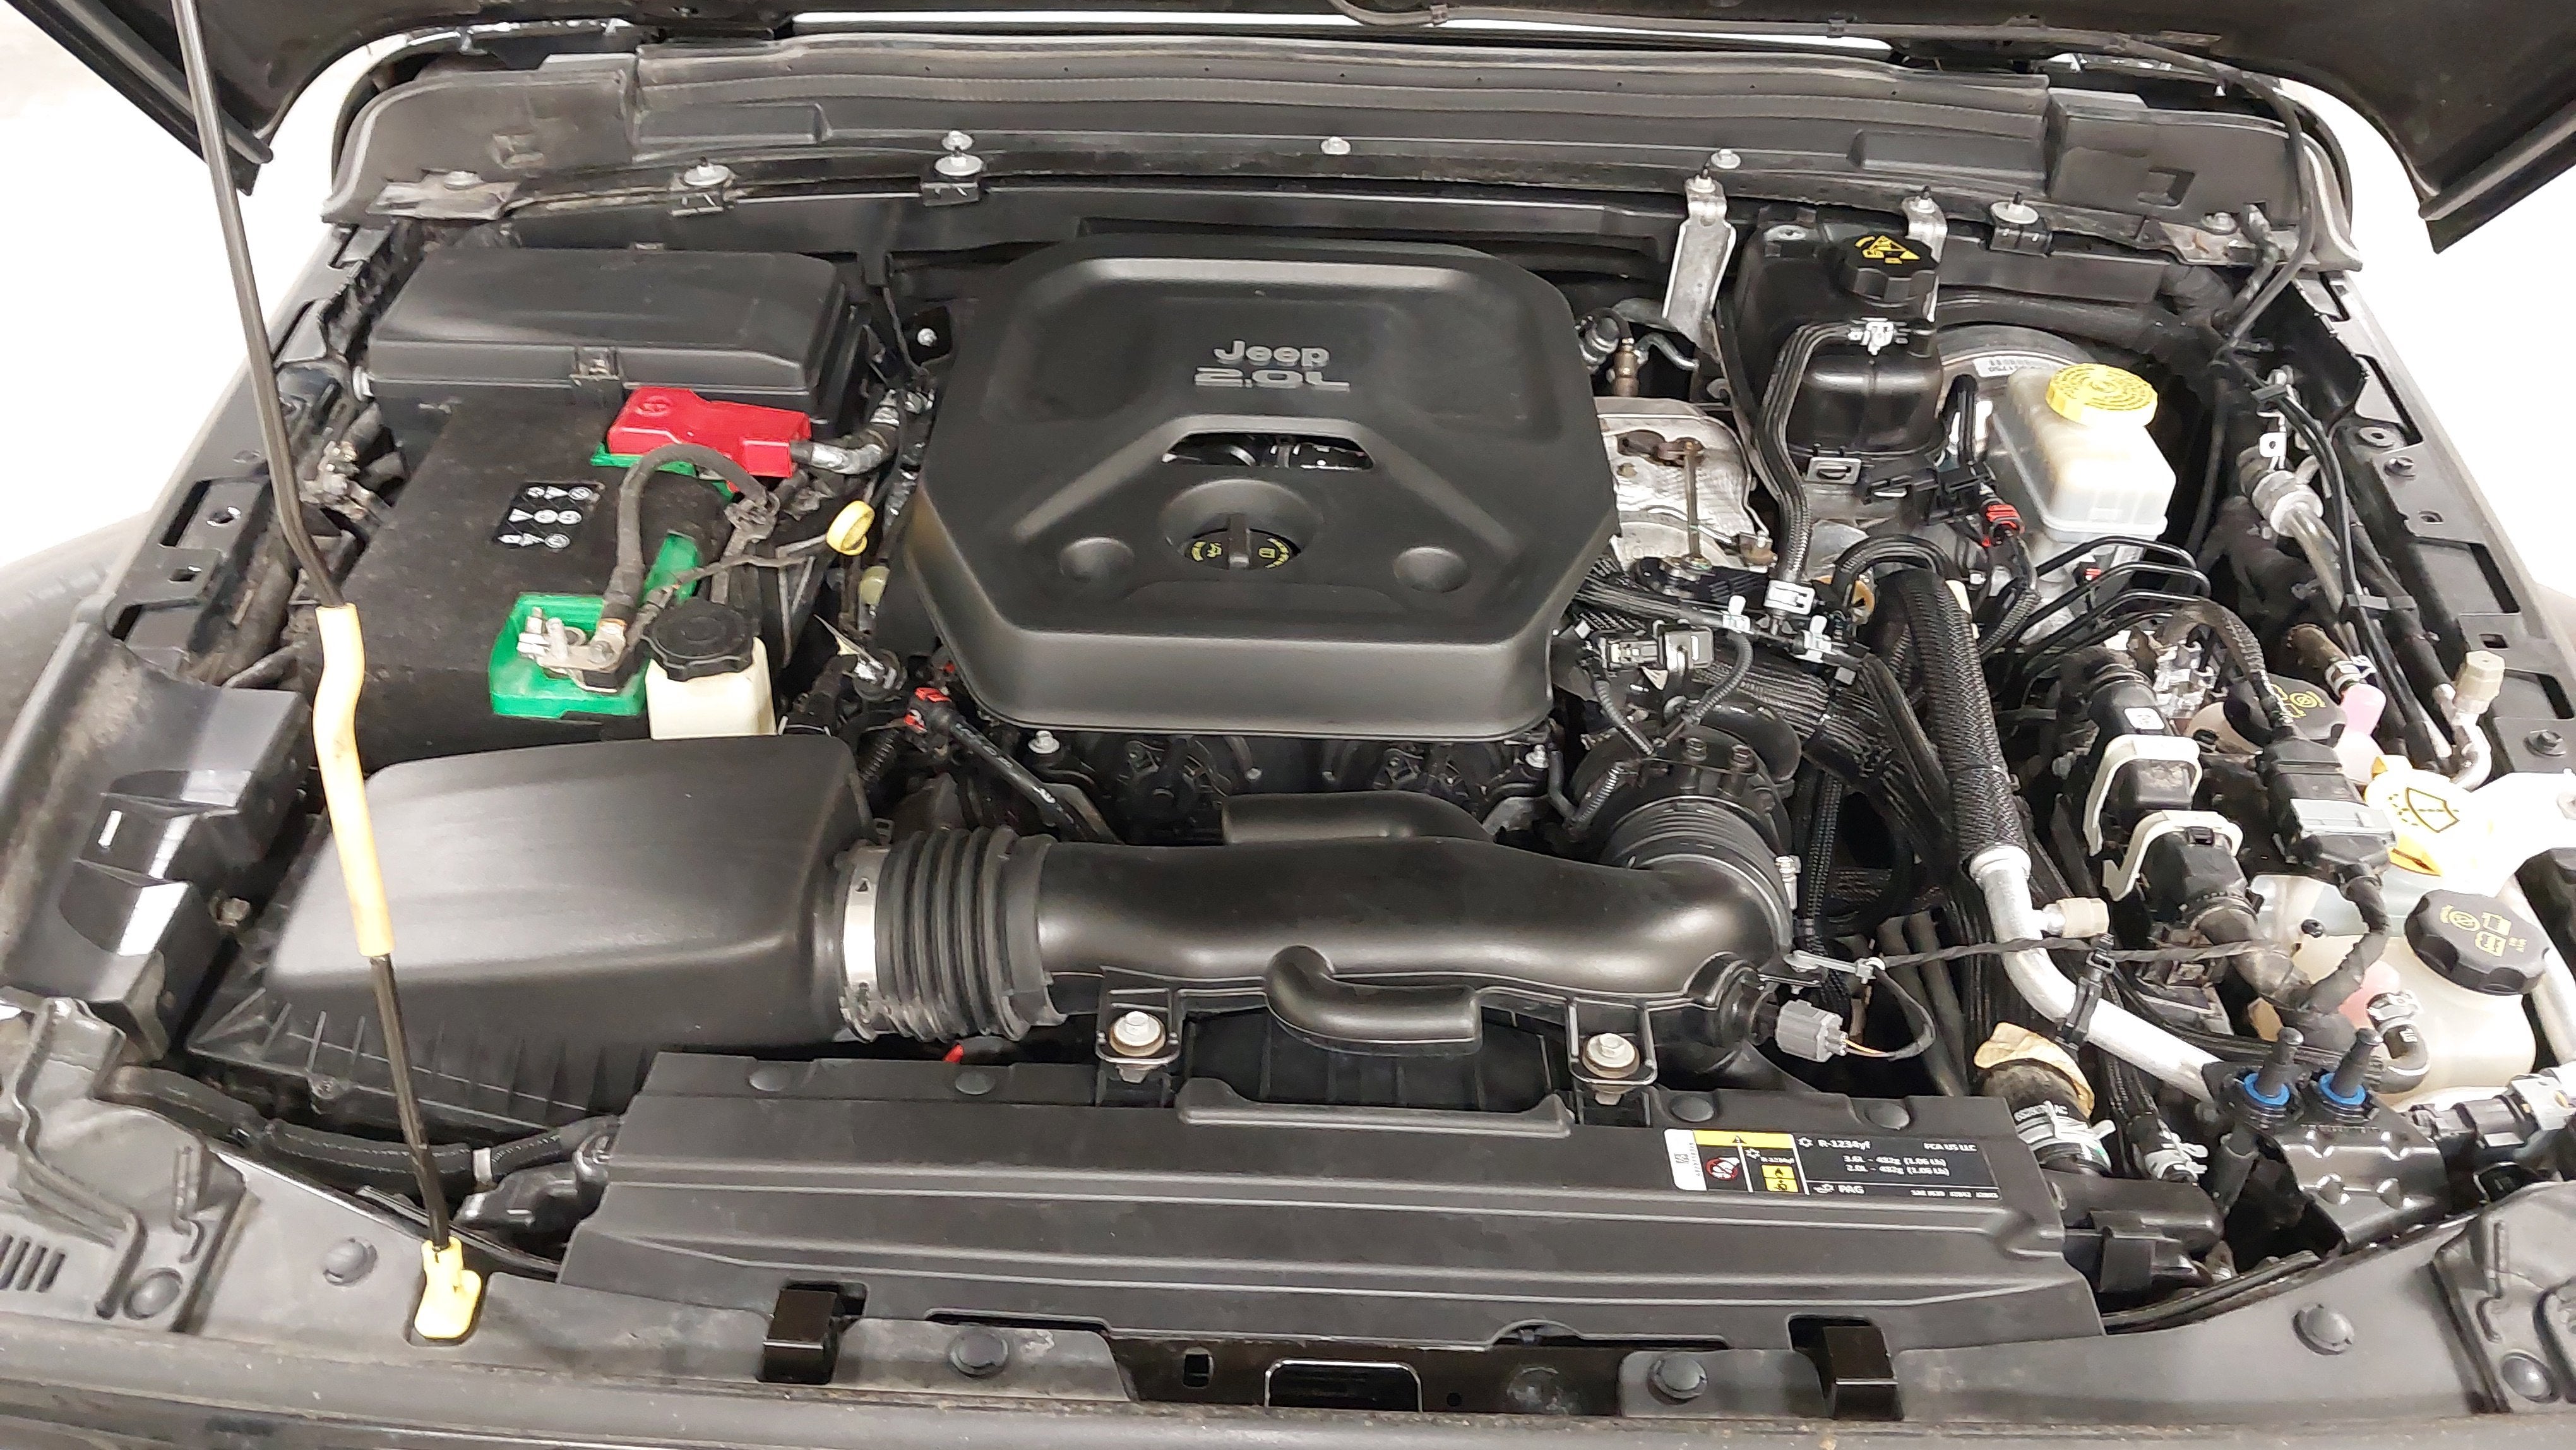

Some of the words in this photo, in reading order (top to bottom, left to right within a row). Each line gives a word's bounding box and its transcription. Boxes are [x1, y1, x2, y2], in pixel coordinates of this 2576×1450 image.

[1213, 340, 1330, 369] Jeep
[1195, 367, 1351, 392] 2.0L
[1817, 1139, 1871, 1151] R-1234yf
[1923, 1142, 1944, 1151] FCA
[1943, 1143, 1959, 1151] US
[1959, 1144, 1977, 1152] LLC
[1837, 1184, 1865, 1194] PAG
